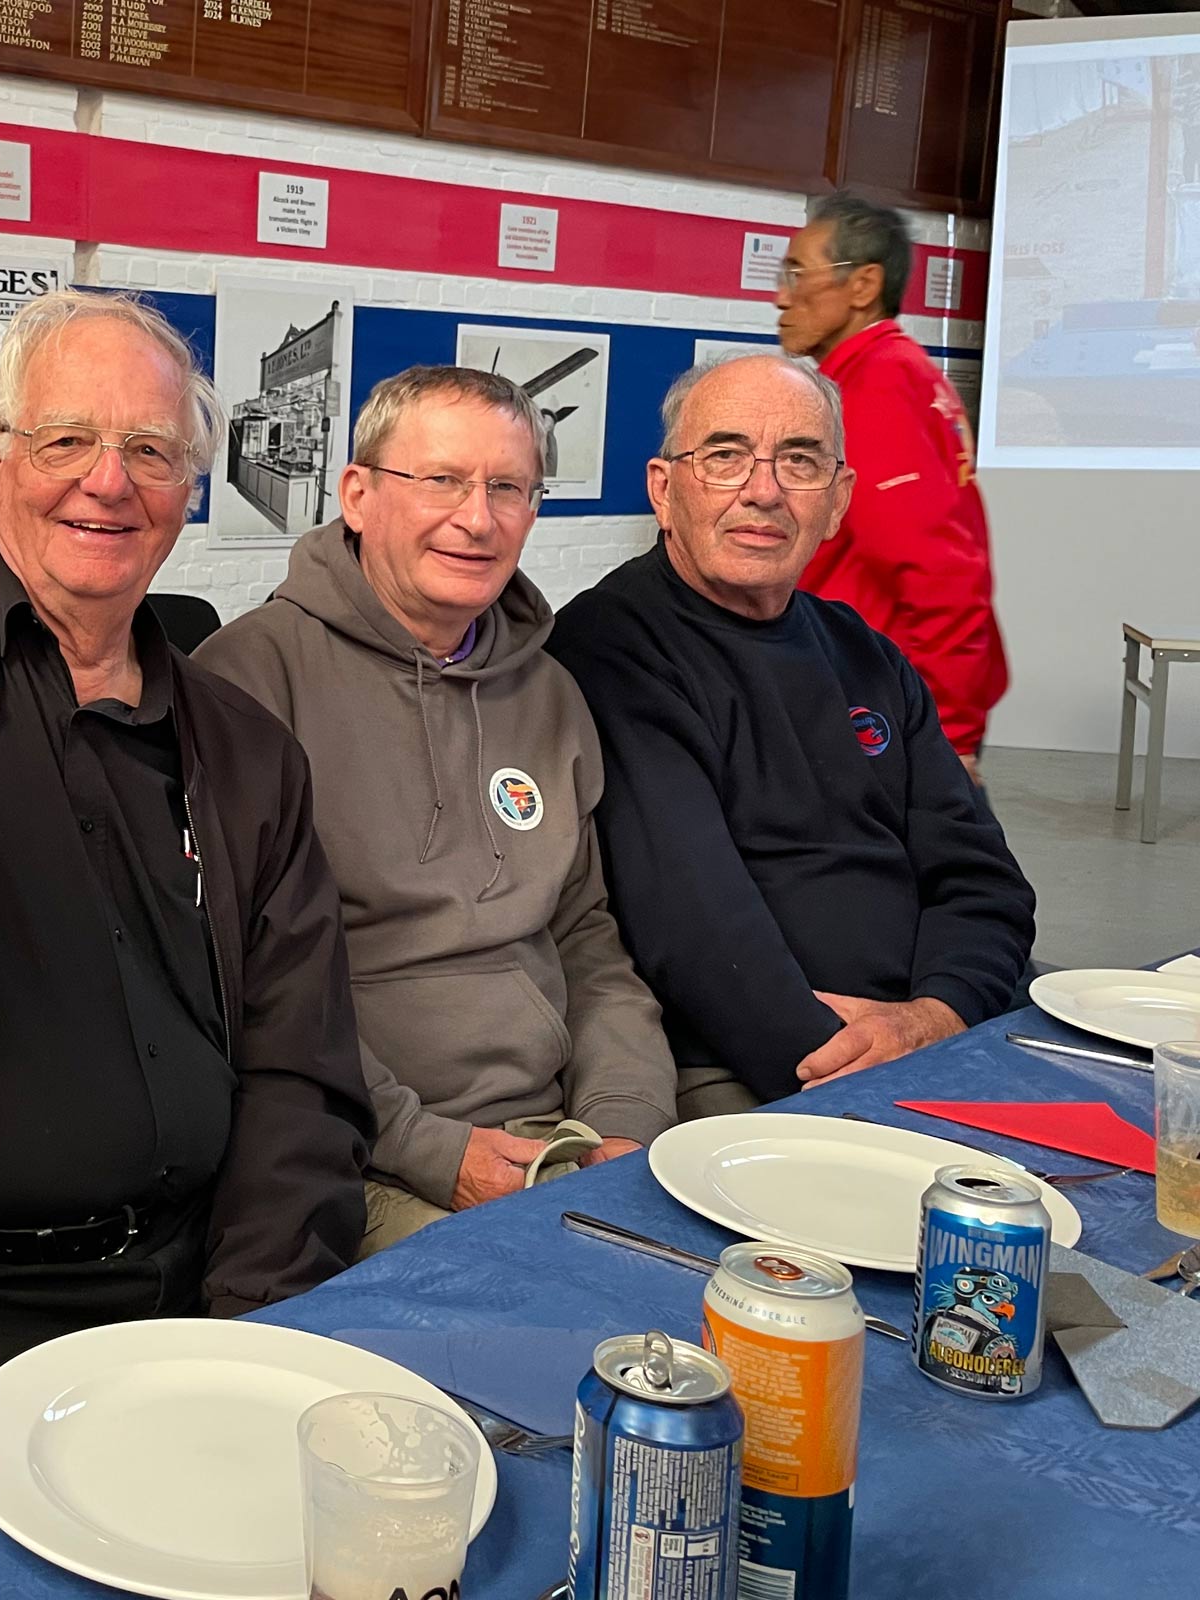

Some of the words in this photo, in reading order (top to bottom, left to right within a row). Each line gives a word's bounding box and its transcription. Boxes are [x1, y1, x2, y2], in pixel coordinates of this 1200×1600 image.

[83, 2, 104, 13] 2000
[82, 12, 104, 22] 2000
[203, 9, 222, 20] 2024
[81, 21, 102, 32] 2001
[81, 30, 102, 42] 2002
[81, 39, 101, 51] 2002
[286, 184, 304, 195] 1919
[928, 1225, 1042, 1289] WINGMAN
[785, 1314, 807, 1326] ALE
[929, 1340, 993, 1375] ALCOHOL
[995, 1357, 1026, 1377] FREE
